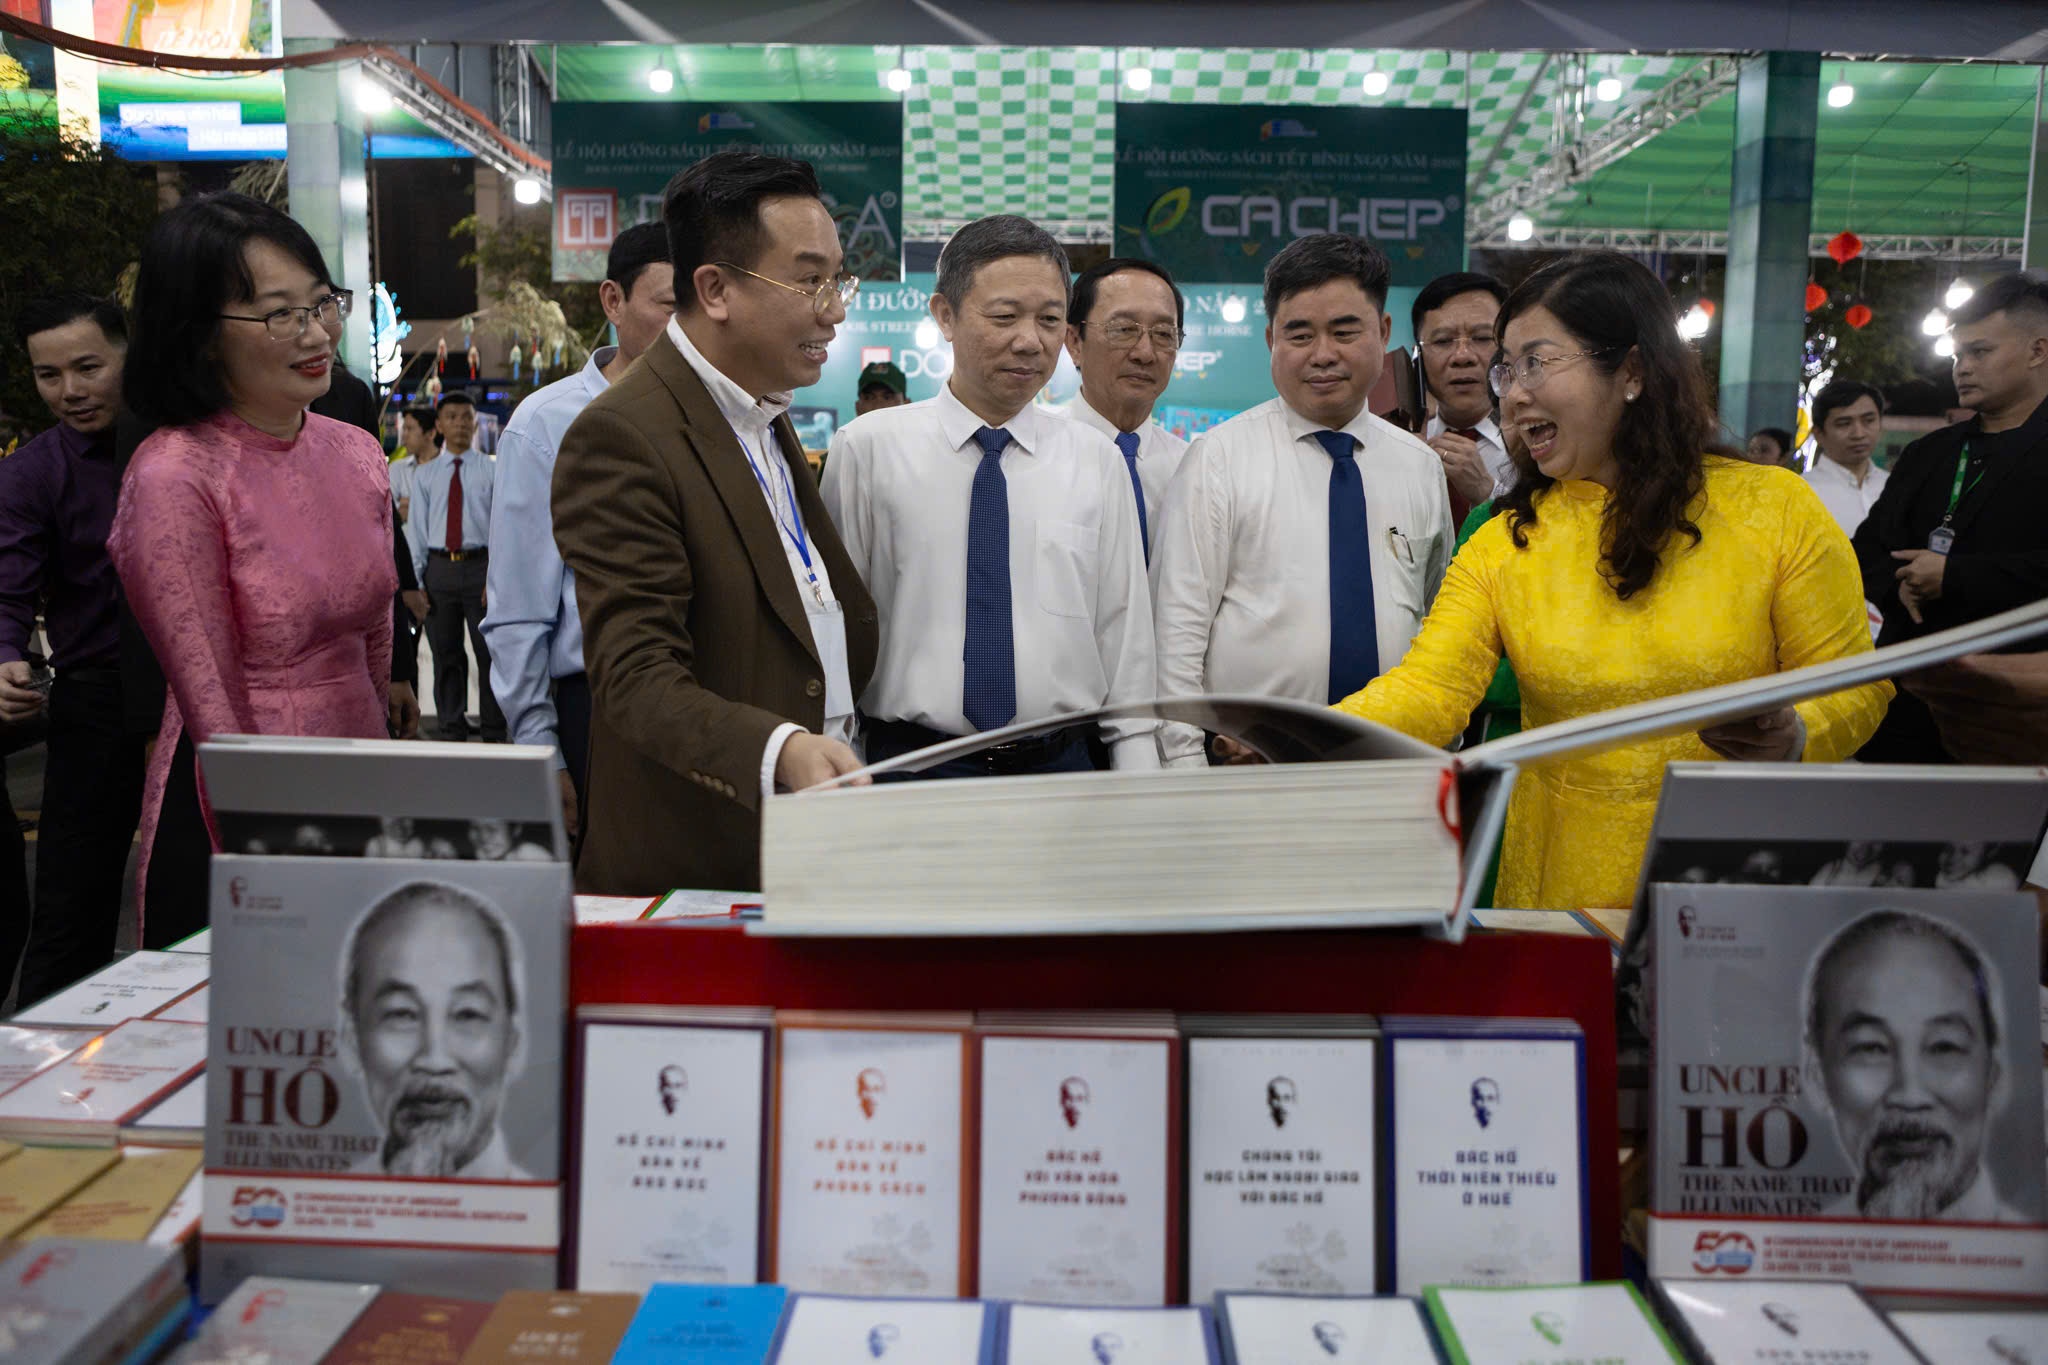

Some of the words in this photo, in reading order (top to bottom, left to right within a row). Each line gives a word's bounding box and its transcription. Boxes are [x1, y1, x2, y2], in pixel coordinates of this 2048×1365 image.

[226, 1026, 338, 1057] UNCLE
[1679, 1063, 1802, 1096] UNCLE
[224, 1130, 262, 1147] THE
[269, 1132, 325, 1152] NAME
[331, 1135, 381, 1154] THAT
[223, 1150, 352, 1170] ILLUMINATES
[1679, 1173, 1726, 1191] THE
[1731, 1175, 1793, 1193] NAME
[1797, 1176, 1856, 1194] THAT
[1679, 1195, 1823, 1214] ILLUMINATES
